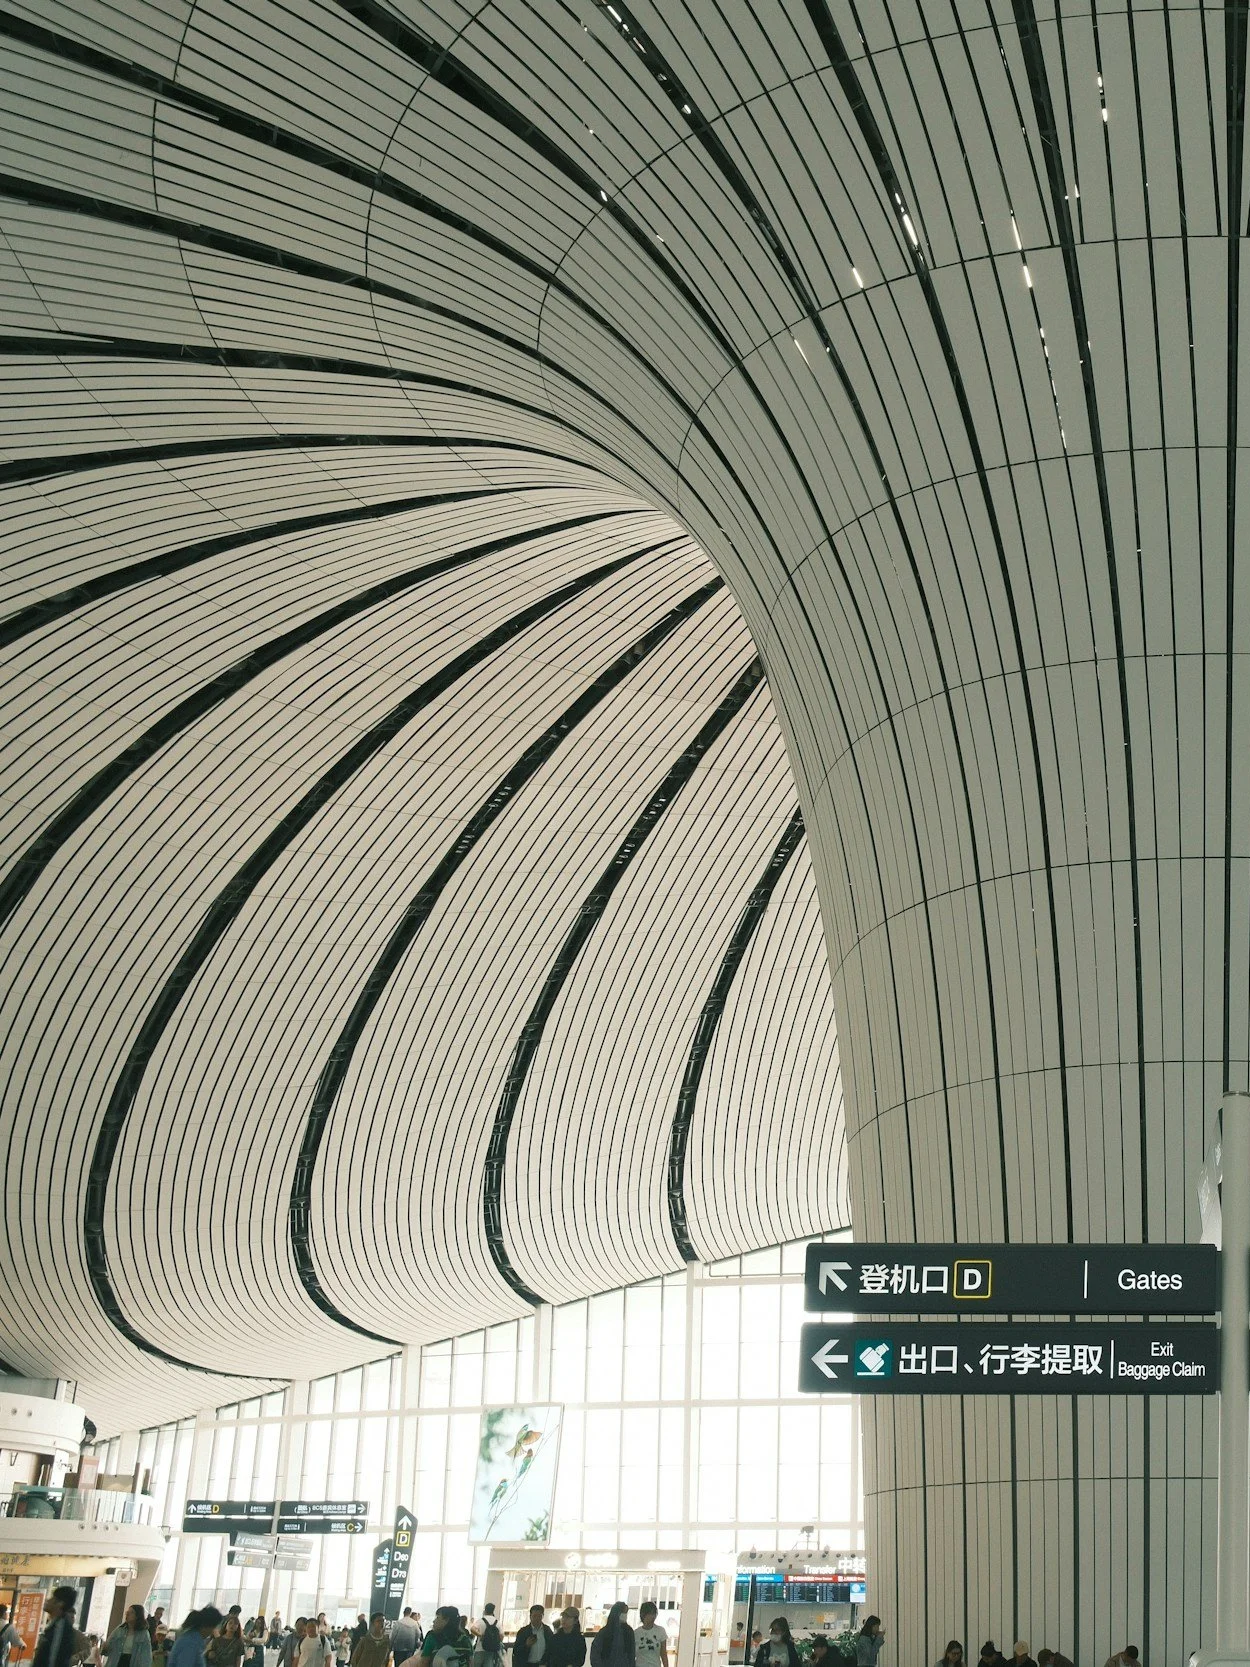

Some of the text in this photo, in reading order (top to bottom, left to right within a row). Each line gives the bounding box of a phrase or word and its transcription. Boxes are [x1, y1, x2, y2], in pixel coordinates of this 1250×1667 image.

[859, 1264, 982, 1295] 登机口 D
[1117, 1268, 1183, 1290] Gates
[1151, 1341, 1174, 1357] Exit
[898, 1343, 1103, 1376] 出口、行李提取
[1118, 1361, 1206, 1380] Baggage Claim
[213, 1504, 220, 1513] D
[399, 1534, 408, 1544] D
[803, 1564, 837, 1575] Transfer
